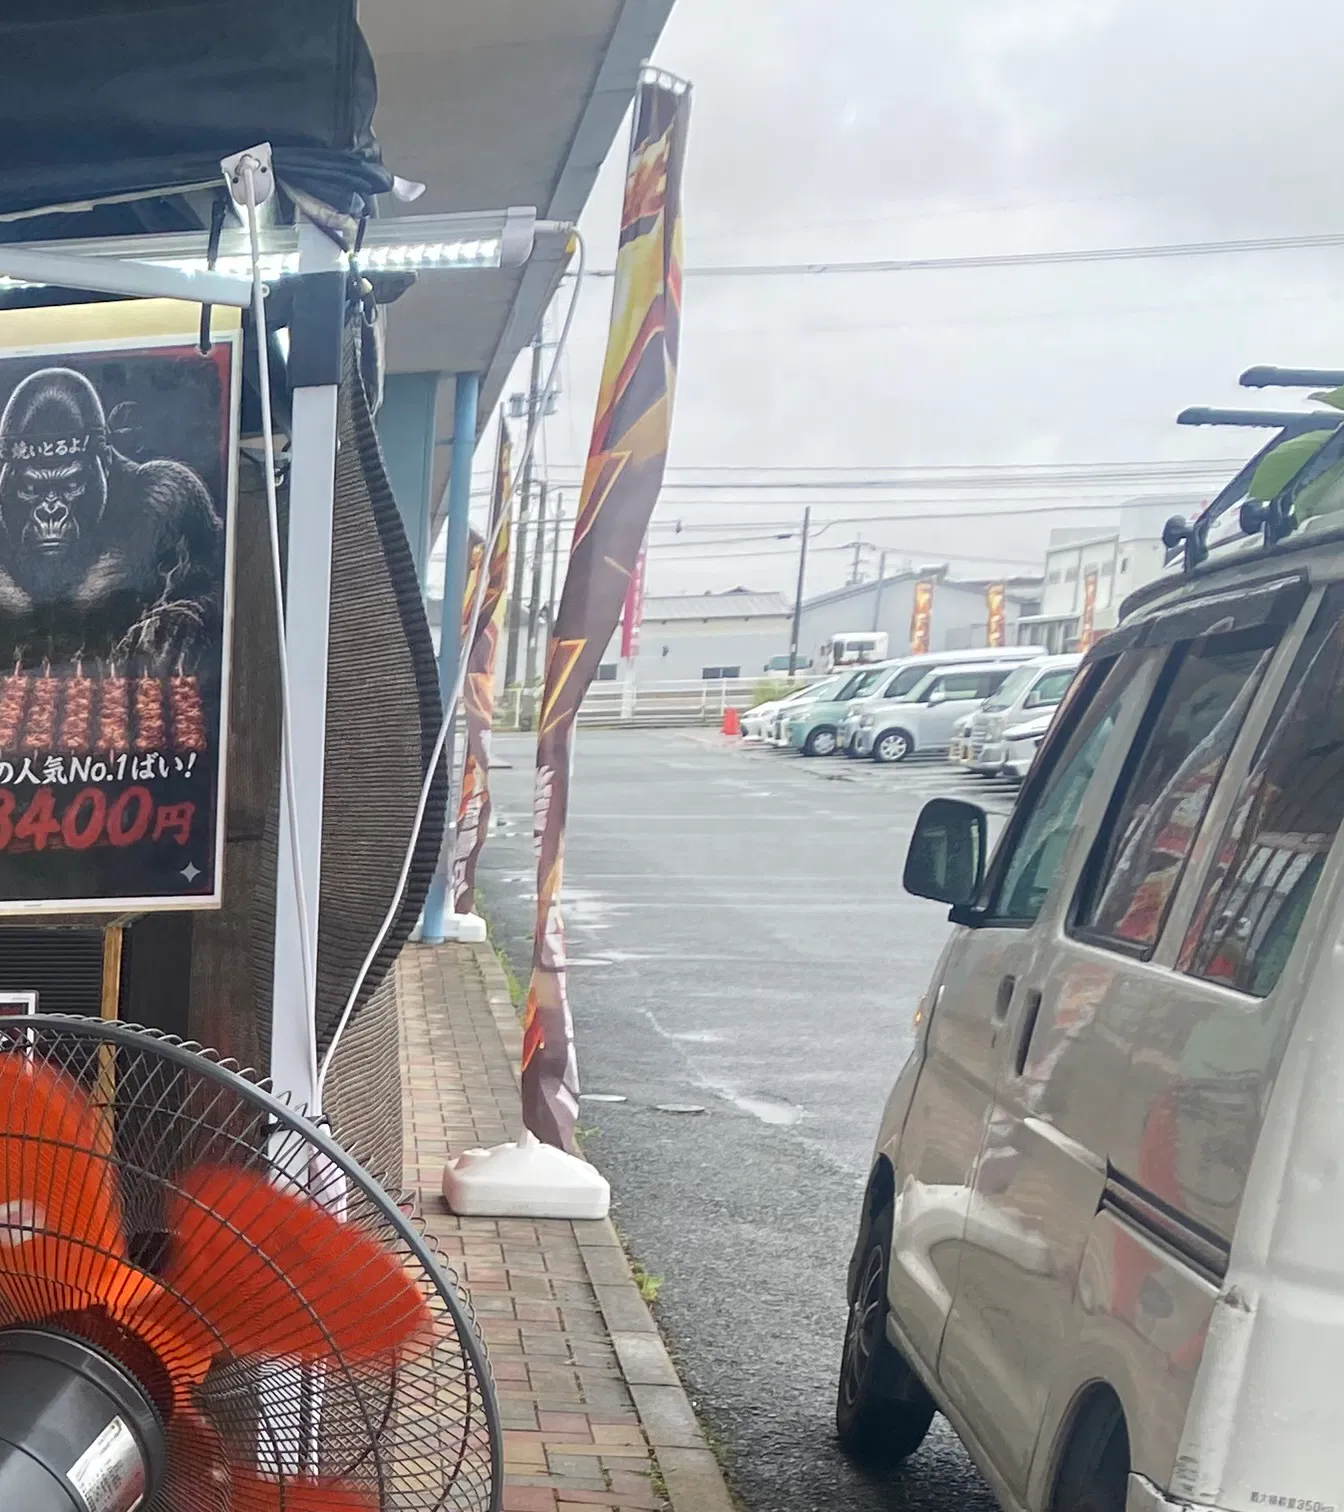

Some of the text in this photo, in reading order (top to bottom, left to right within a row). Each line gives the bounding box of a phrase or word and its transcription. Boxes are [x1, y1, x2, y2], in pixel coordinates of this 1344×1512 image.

[12, 435, 90, 460] 焼いとるよ!
